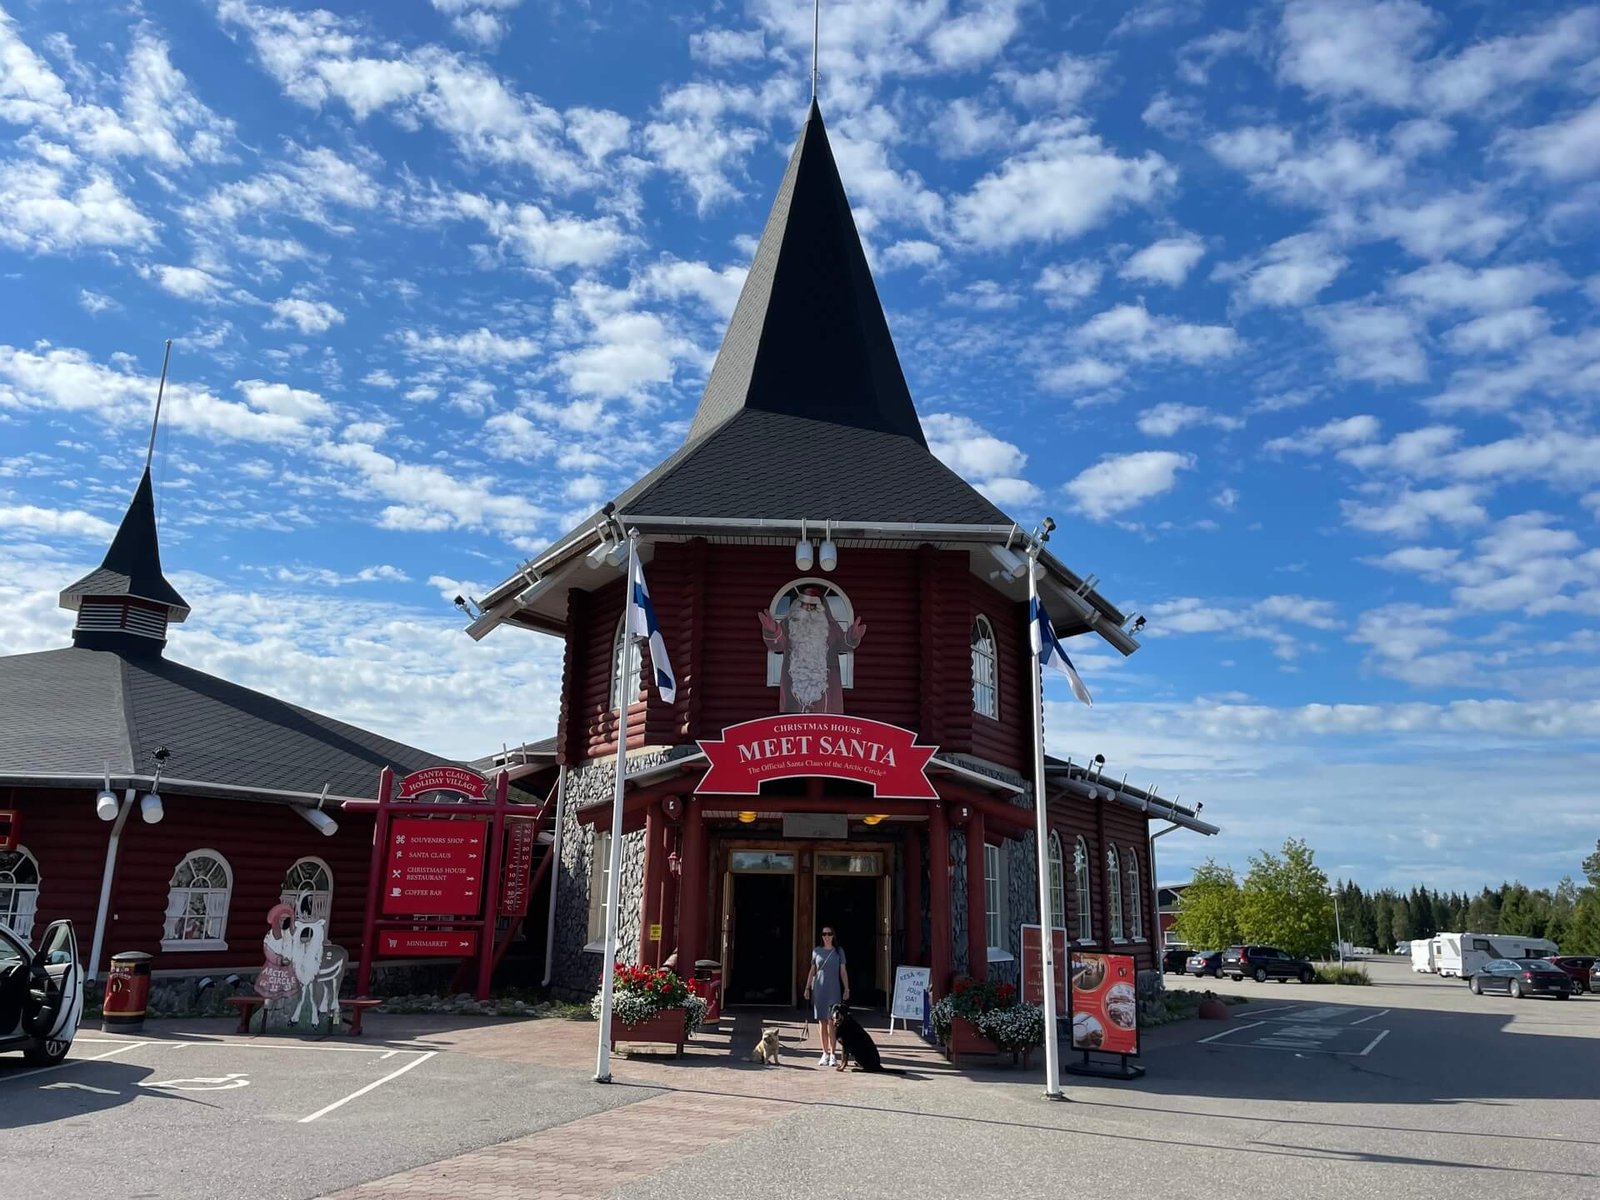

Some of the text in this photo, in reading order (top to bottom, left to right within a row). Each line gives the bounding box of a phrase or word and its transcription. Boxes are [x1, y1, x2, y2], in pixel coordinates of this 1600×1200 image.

[773, 722, 862, 735] CHRISTMAS HOUSE
[737, 736, 897, 768] MEET SANTA
[747, 766, 760, 775] The
[761, 762, 786, 772] Official
[786, 760, 804, 768] Santa
[824, 760, 832, 768] of
[844, 762, 863, 772] Arctic
[418, 770, 471, 782] SANTA CLAUS
[409, 777, 478, 792] HOLIDAY VILLAGE
[410, 836, 446, 844] SOUVENIRS
[262, 967, 289, 977] ARCTIC
[268, 976, 296, 985] CIRCLE
